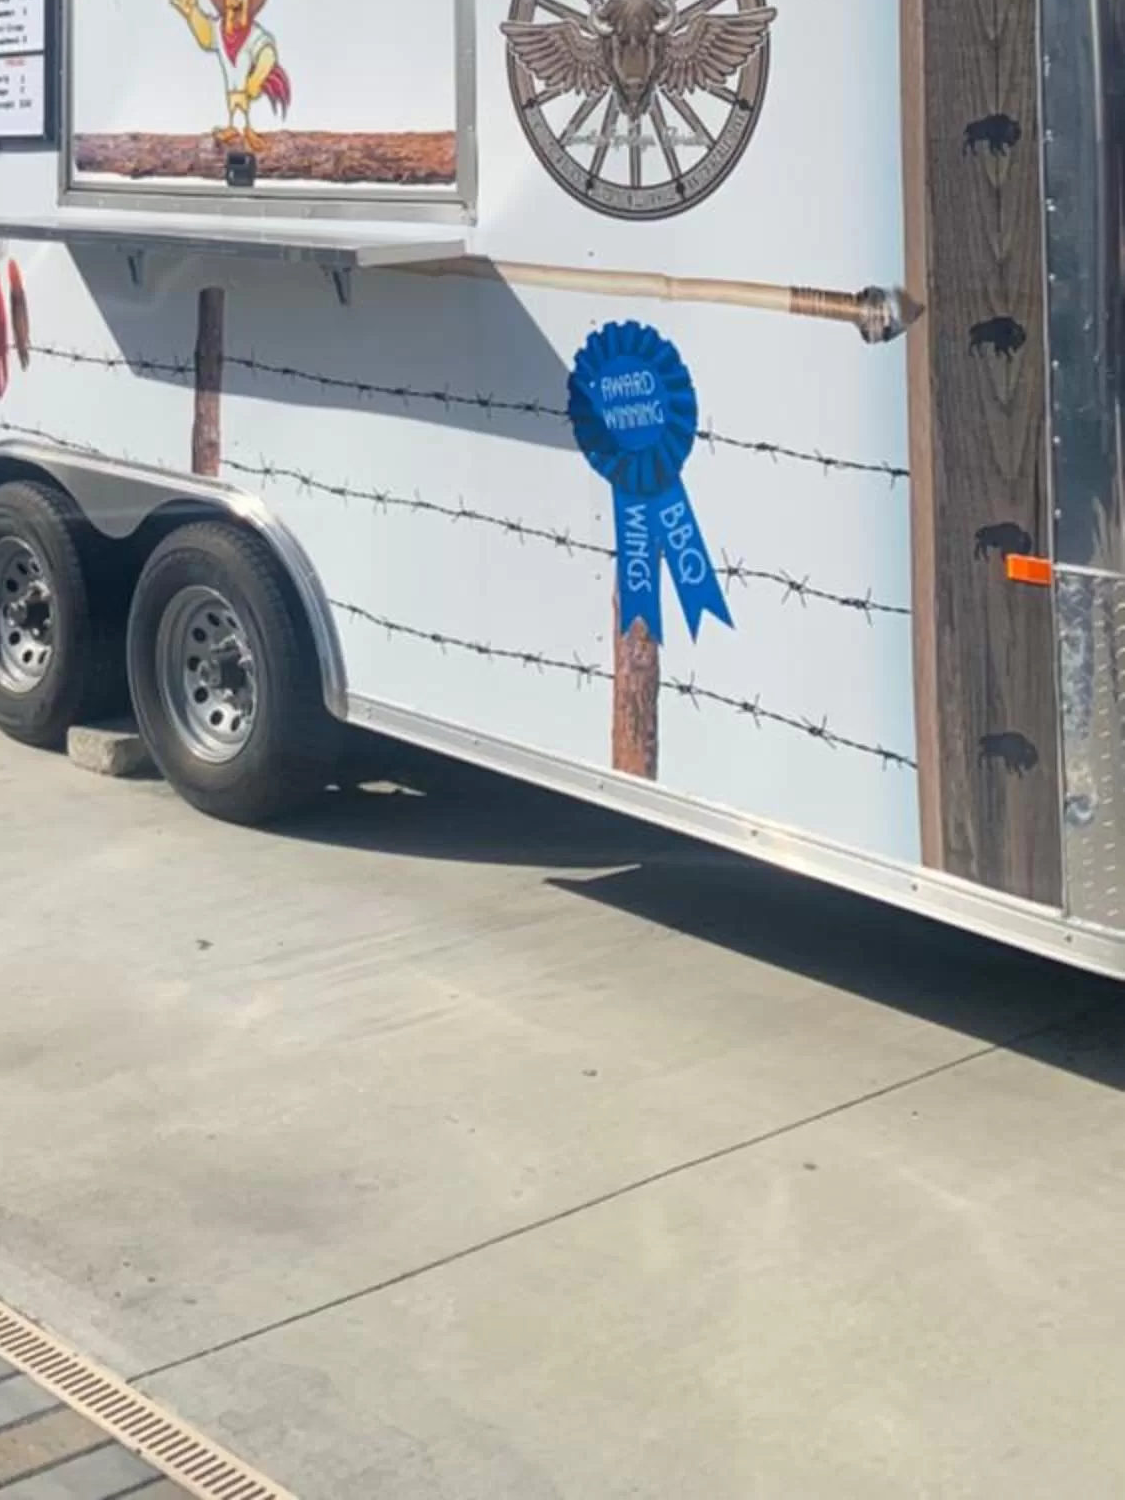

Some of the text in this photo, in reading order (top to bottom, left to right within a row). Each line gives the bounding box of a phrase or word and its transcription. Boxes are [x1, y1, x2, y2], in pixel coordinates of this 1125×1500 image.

[600, 370, 656, 401] AWARD
[602, 400, 664, 430] WINNING
[623, 503, 652, 593] WINGS
[659, 501, 707, 586] BBQ
